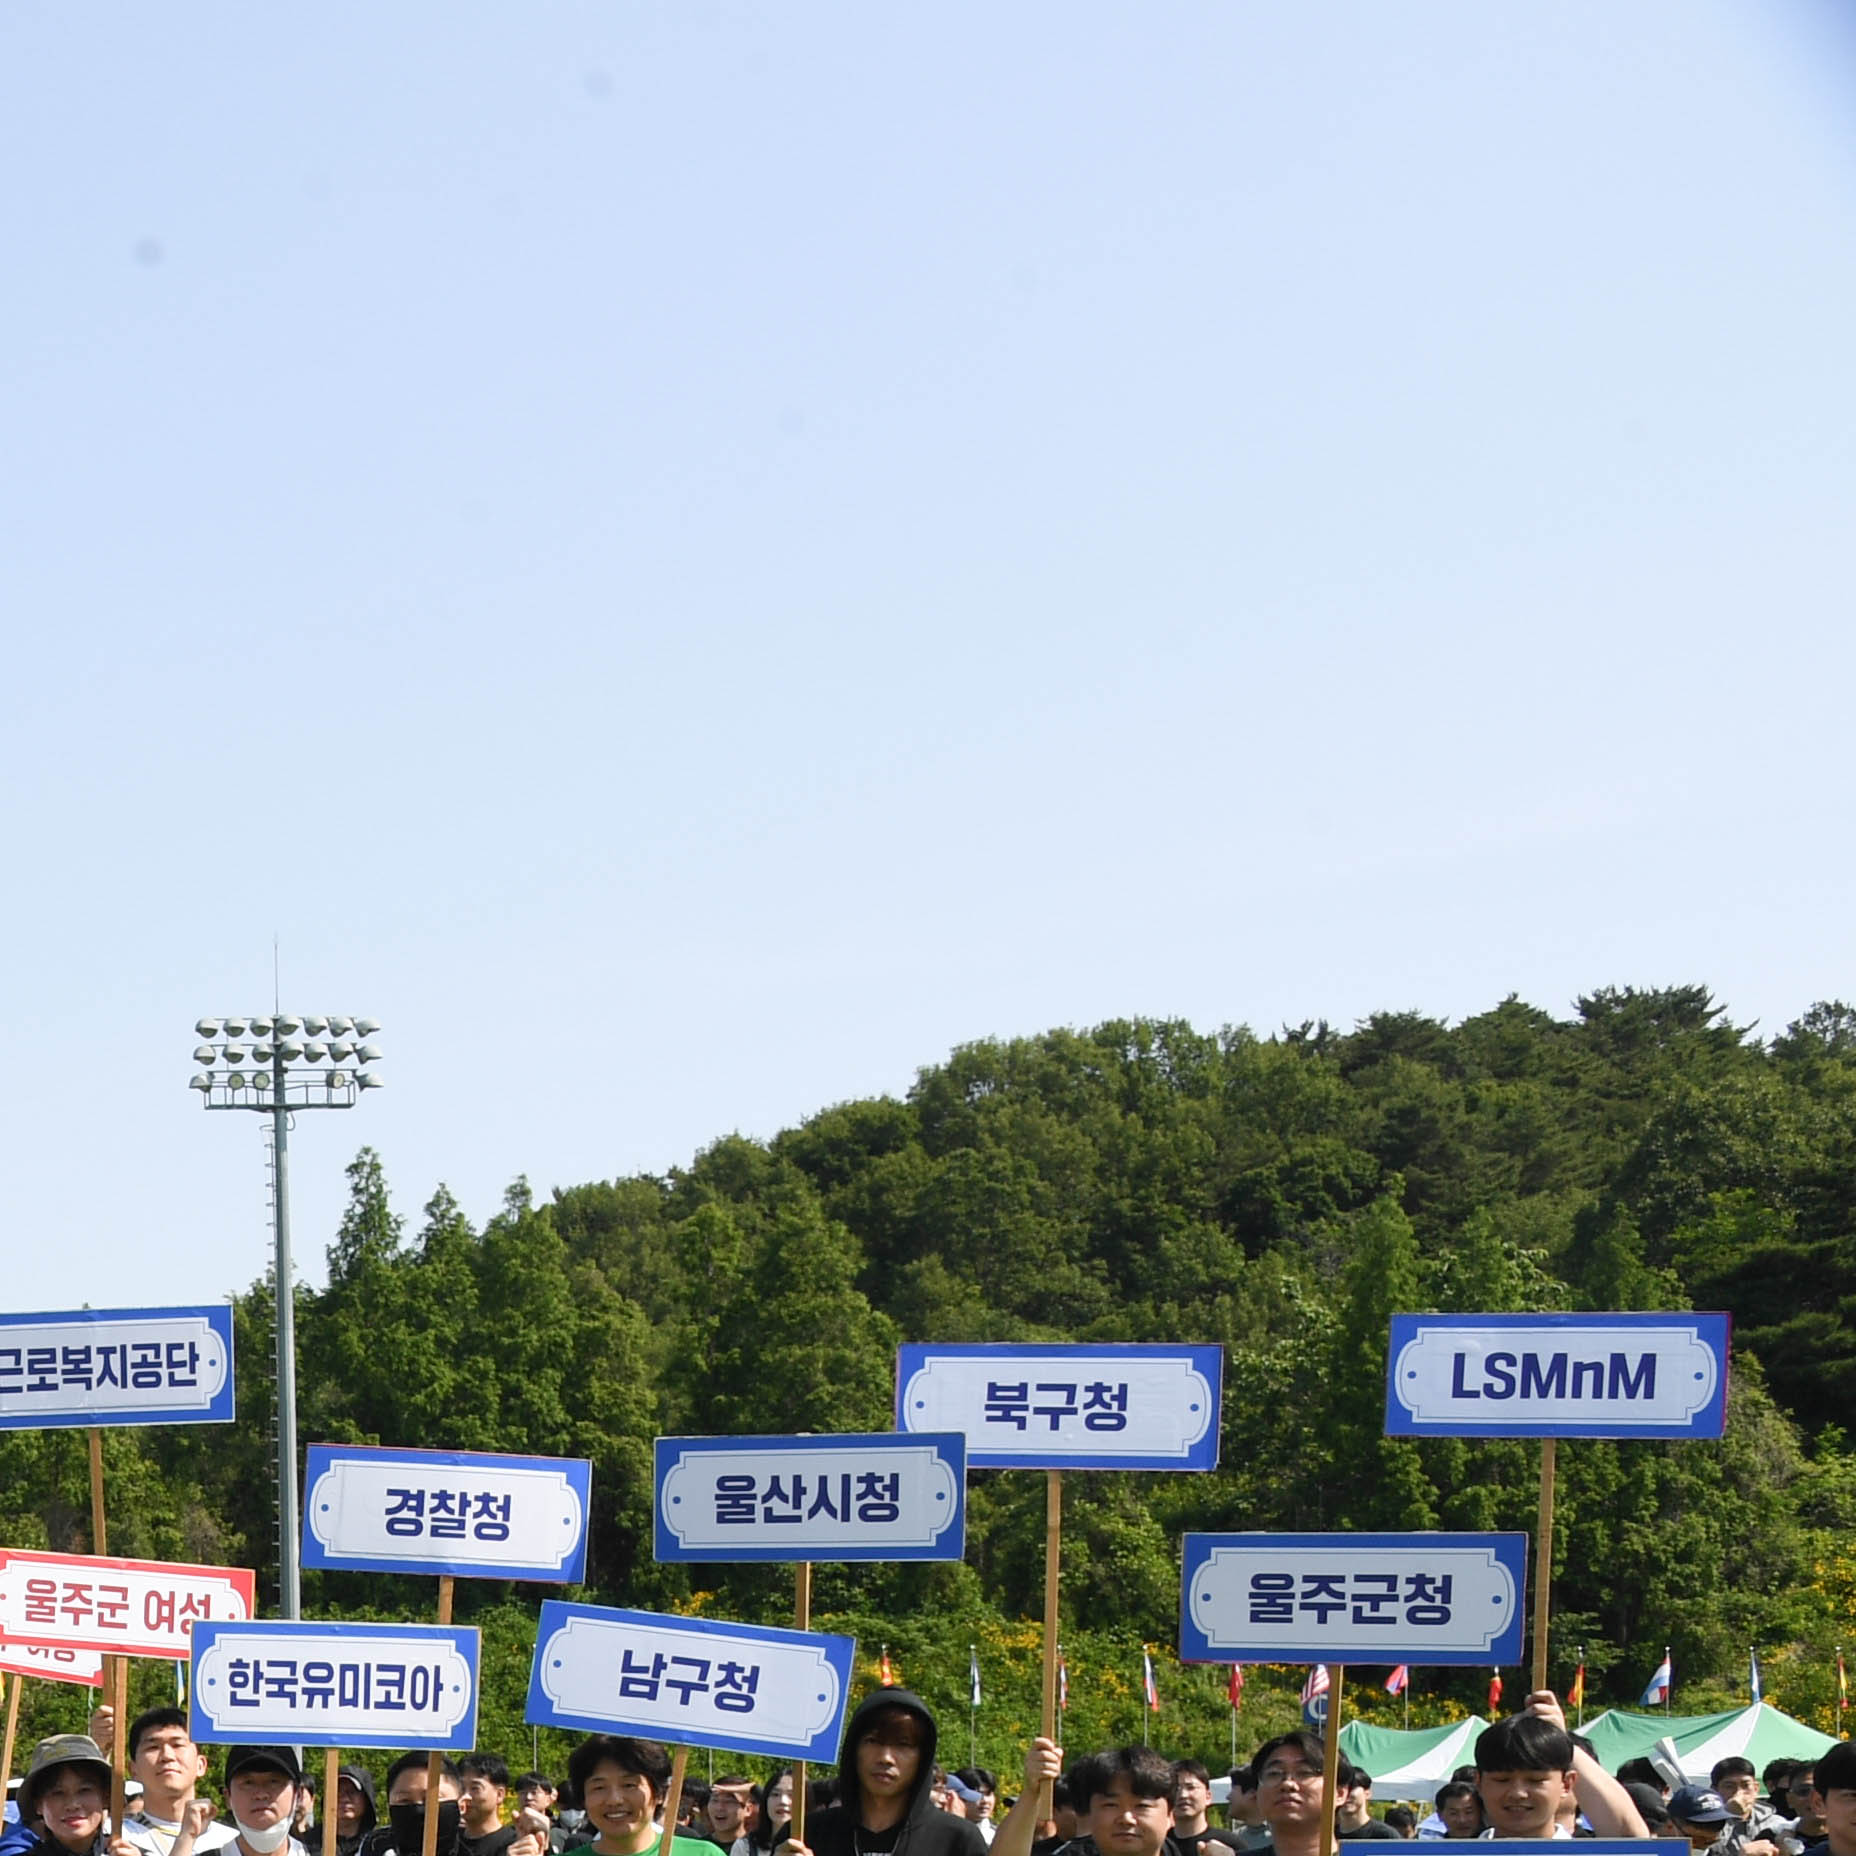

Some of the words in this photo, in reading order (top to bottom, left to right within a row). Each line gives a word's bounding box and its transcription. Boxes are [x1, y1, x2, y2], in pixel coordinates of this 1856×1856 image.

[1452, 1352, 1656, 1399] LSMnM
[985, 1382, 1128, 1431] 북구청
[385, 1489, 511, 1541] 경찰청
[715, 1472, 899, 1524] 울산시청
[25, 1579, 129, 1629] 울주군
[144, 1590, 211, 1635] 여성
[1249, 1574, 1452, 1625] 울주군청
[229, 1659, 443, 1712] 한국유미코아
[619, 1650, 760, 1713] 남구청
